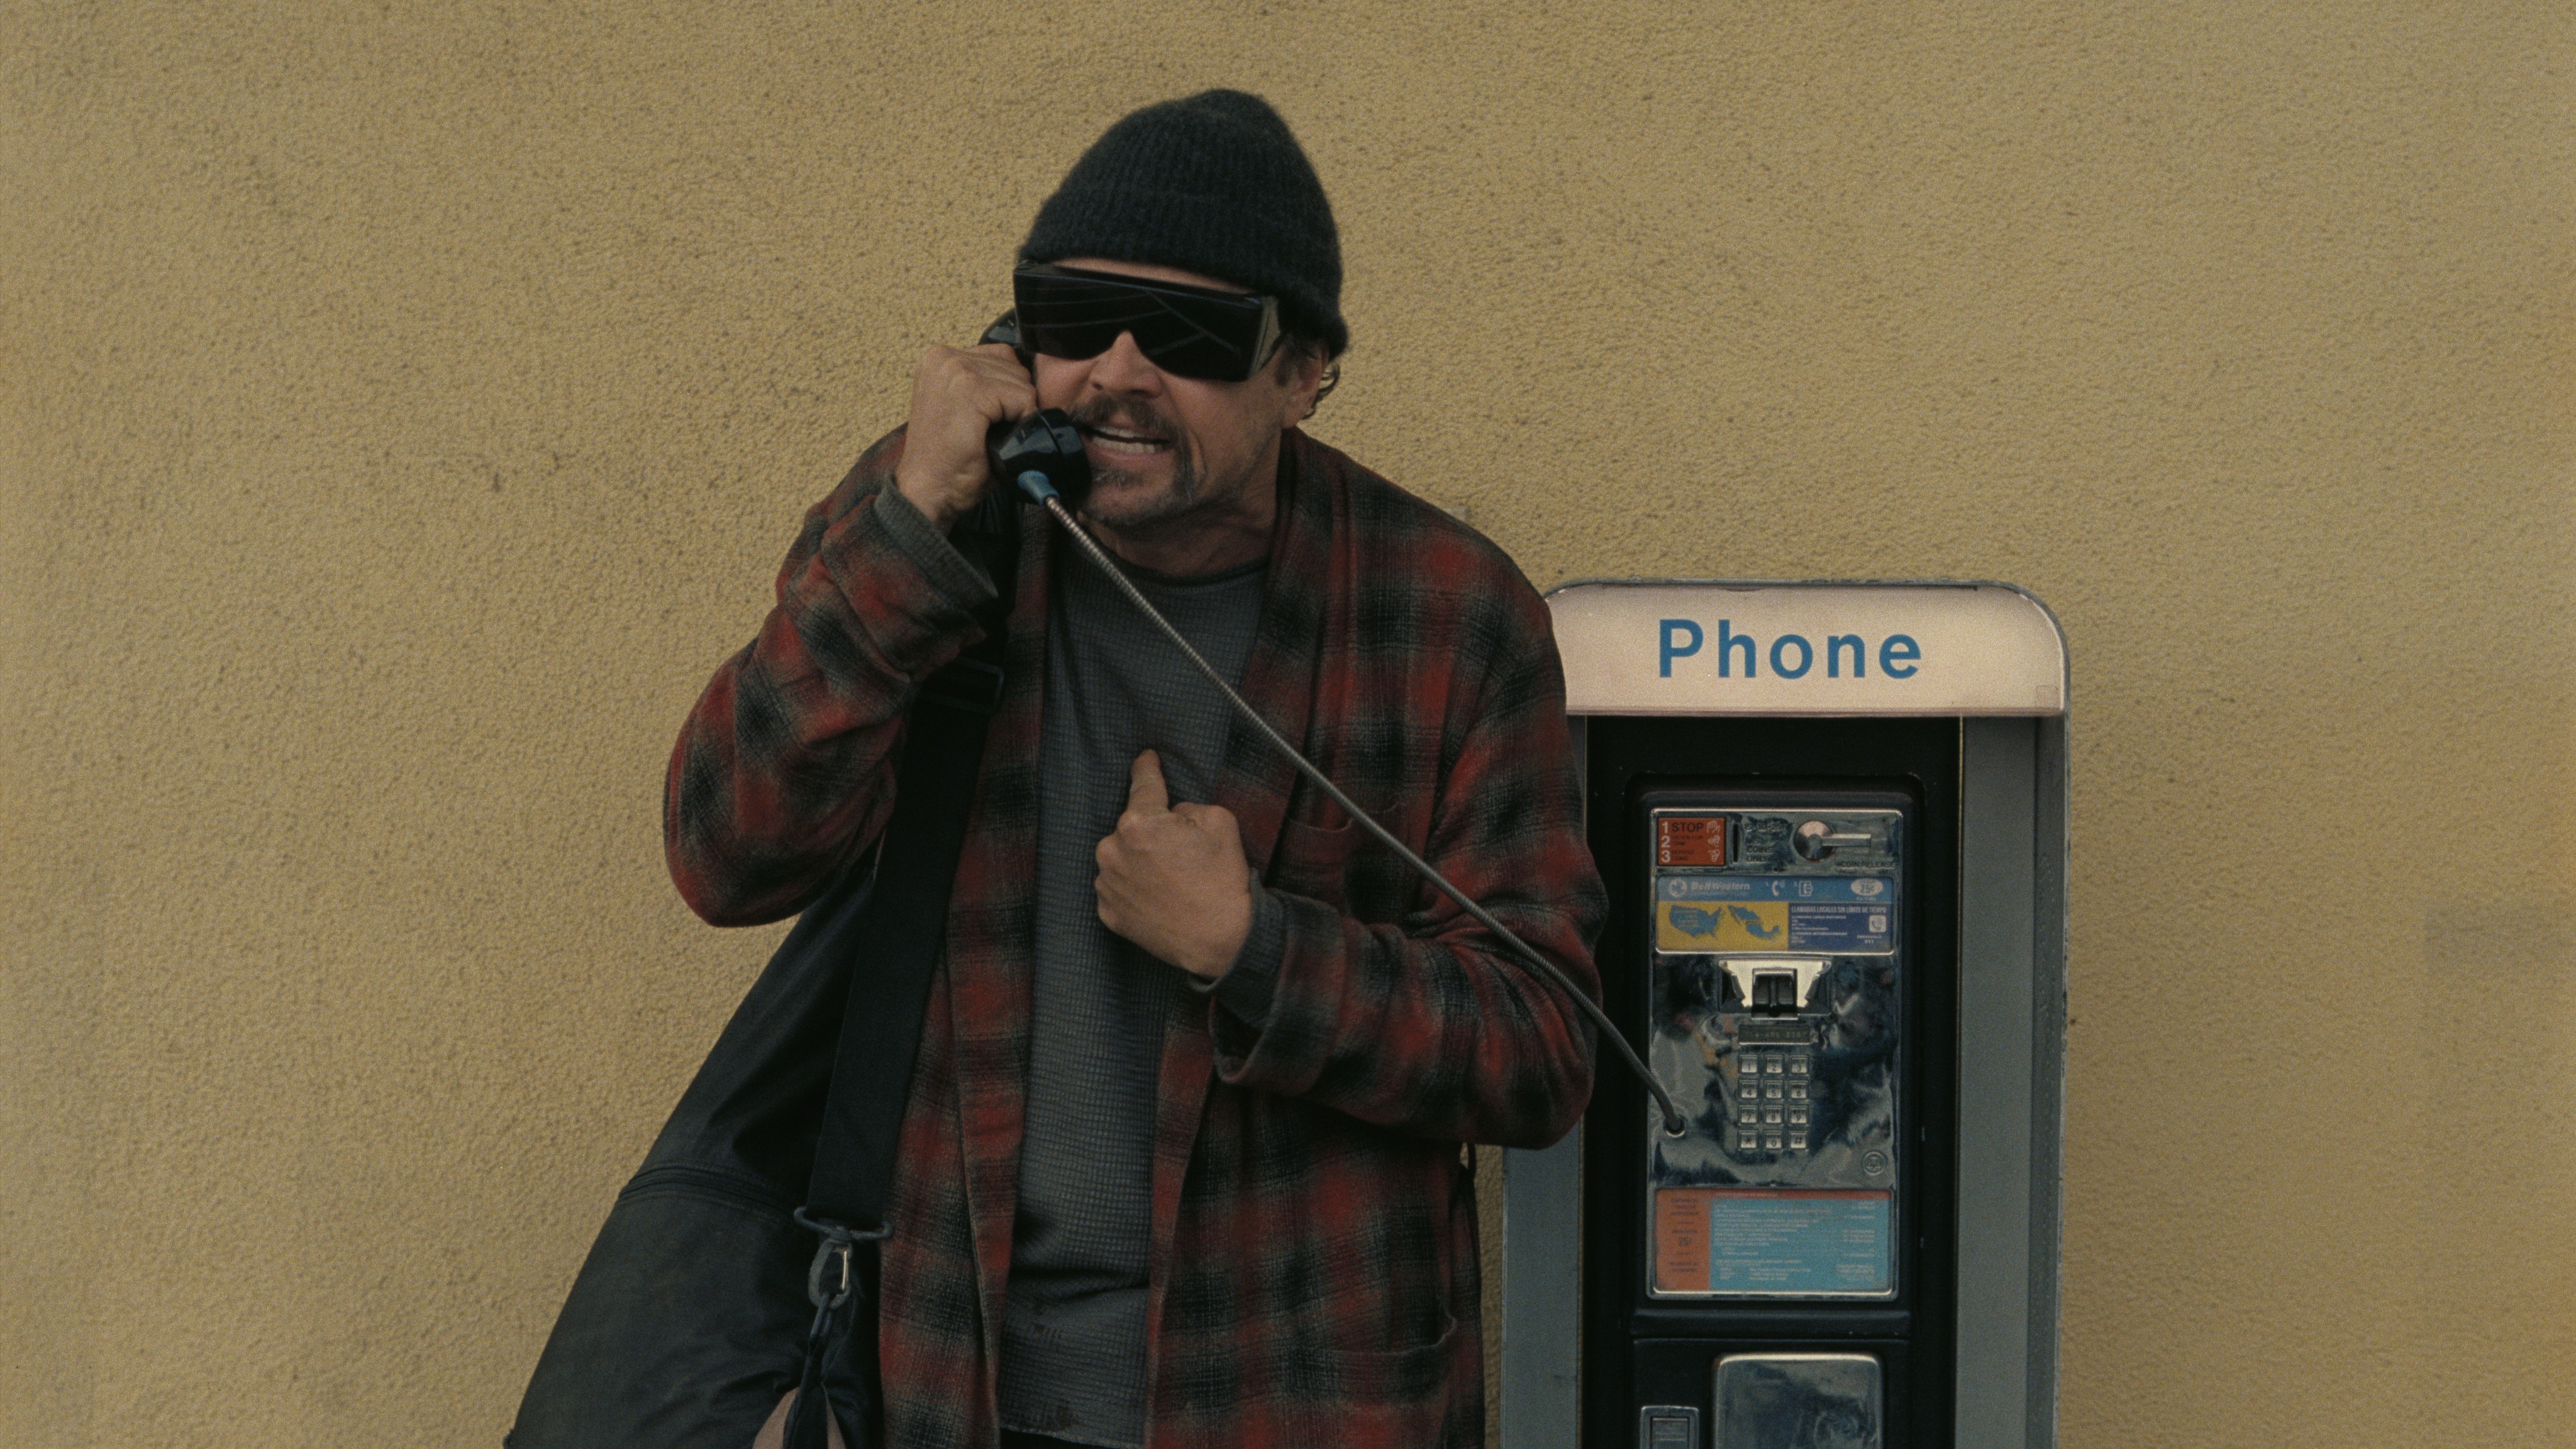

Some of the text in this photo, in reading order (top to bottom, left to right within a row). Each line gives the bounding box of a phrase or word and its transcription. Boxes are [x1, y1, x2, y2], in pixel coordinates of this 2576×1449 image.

[1659, 619, 1921, 680] Phone
[1662, 821, 1704, 834] 1 STOP
[1661, 835, 1670, 848] 2
[1661, 850, 1671, 863] 3
